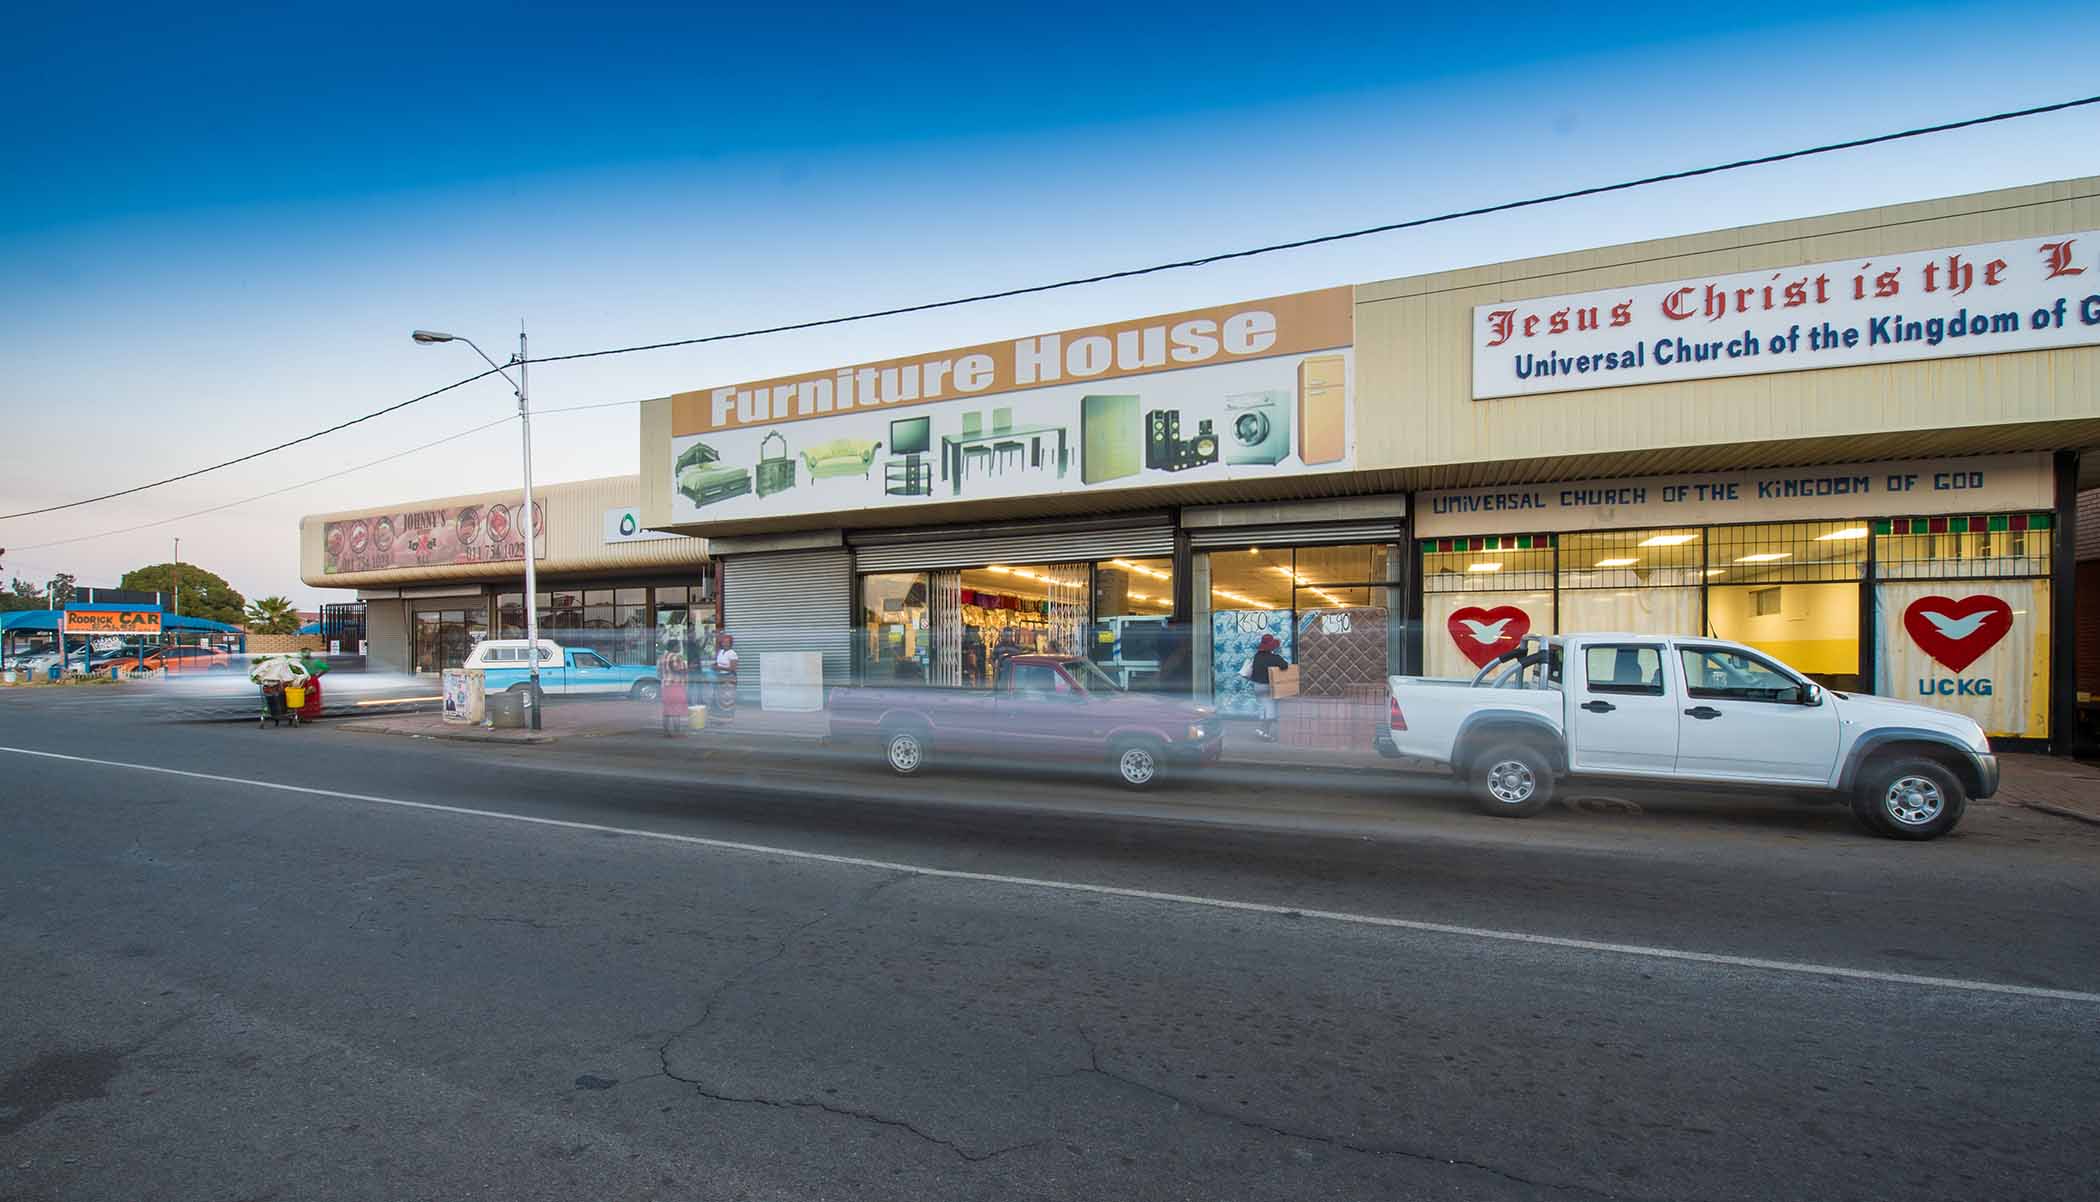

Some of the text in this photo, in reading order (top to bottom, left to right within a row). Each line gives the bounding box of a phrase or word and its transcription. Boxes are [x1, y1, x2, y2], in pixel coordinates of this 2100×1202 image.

[1486, 299, 1633, 348] Jesus
[1661, 272, 1831, 322] Christ
[1853, 262, 1901, 300] is
[1923, 253, 2008, 297] the
[1515, 341, 1645, 379] Universal
[1653, 329, 1760, 366] Church
[1767, 323, 1800, 355] of
[1808, 322, 1860, 351] the
[1869, 308, 2019, 346] Kingdom
[2031, 297, 2067, 330] of
[711, 310, 1277, 427] Furniture House
[1560, 487, 1648, 507] CHURCH
[1663, 485, 1688, 502] OF
[1694, 482, 1741, 501] THE
[1886, 474, 1918, 492] OF
[403, 510, 447, 533] JOHNNY'S
[68, 611, 159, 625] RODRICK CAR
[1919, 678, 1993, 696] UCKG
